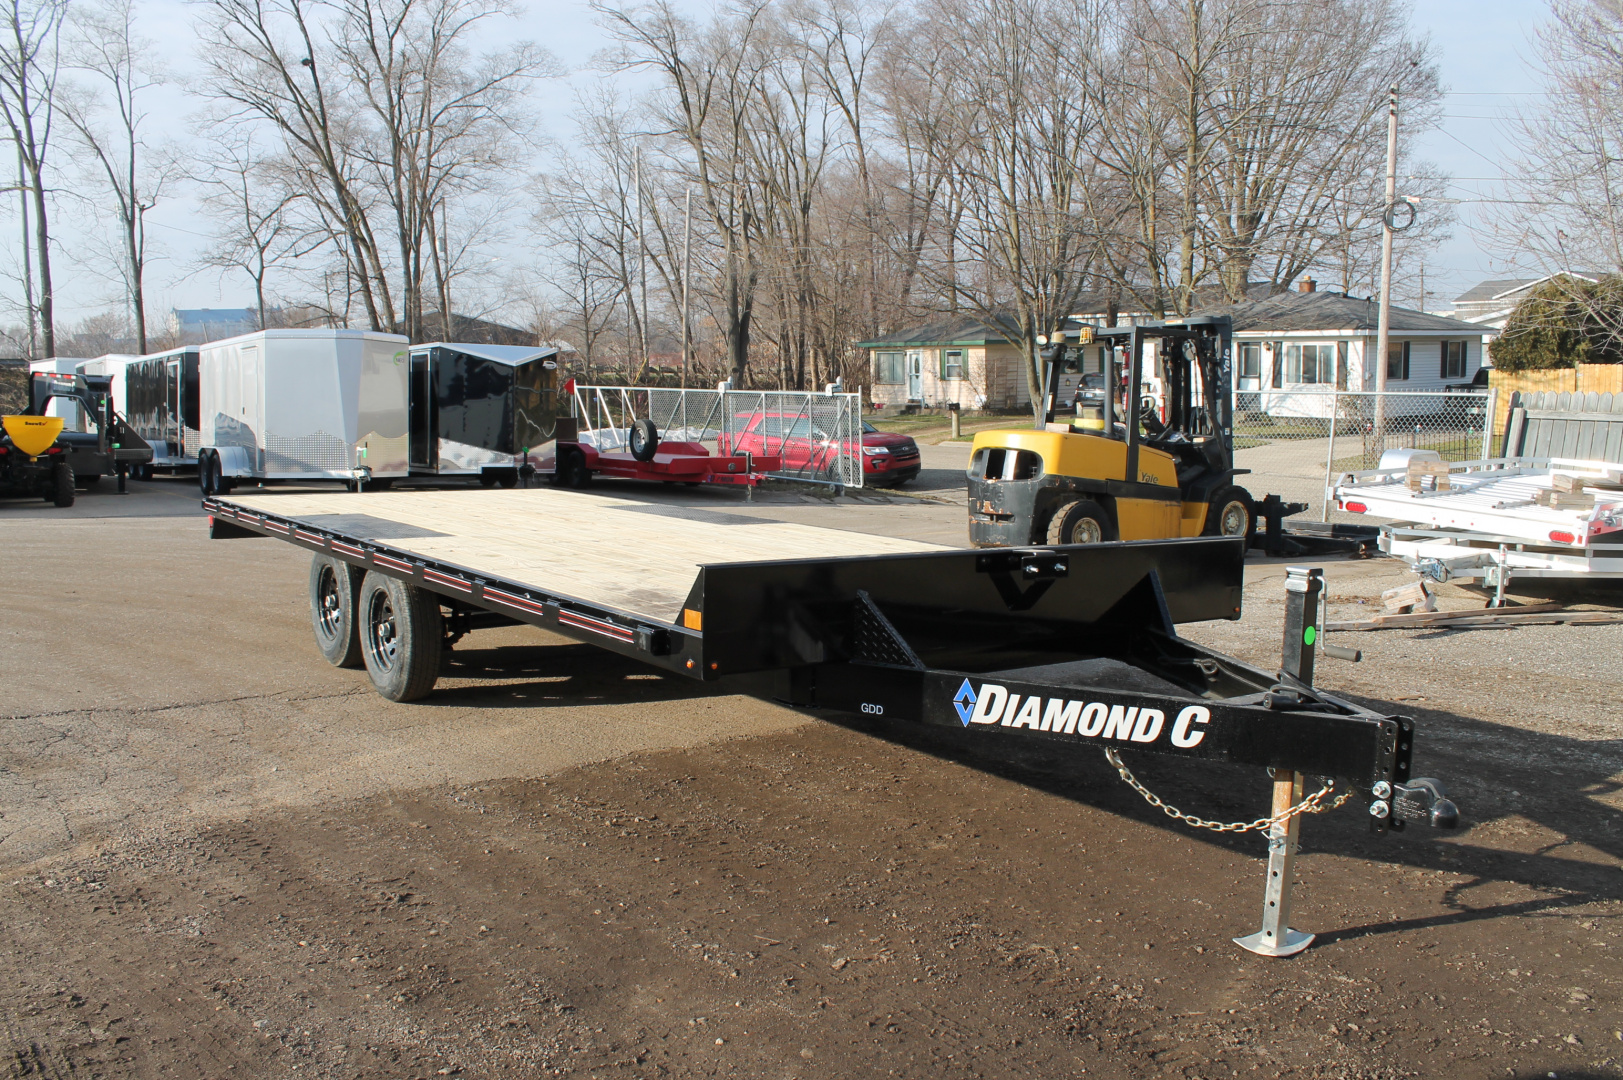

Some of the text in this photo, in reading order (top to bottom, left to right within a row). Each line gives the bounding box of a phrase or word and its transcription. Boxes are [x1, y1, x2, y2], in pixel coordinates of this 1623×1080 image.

[1141, 472, 1159, 484] Yale
[860, 702, 884, 716] GDD
[970, 683, 1211, 748] DIAMOND C
